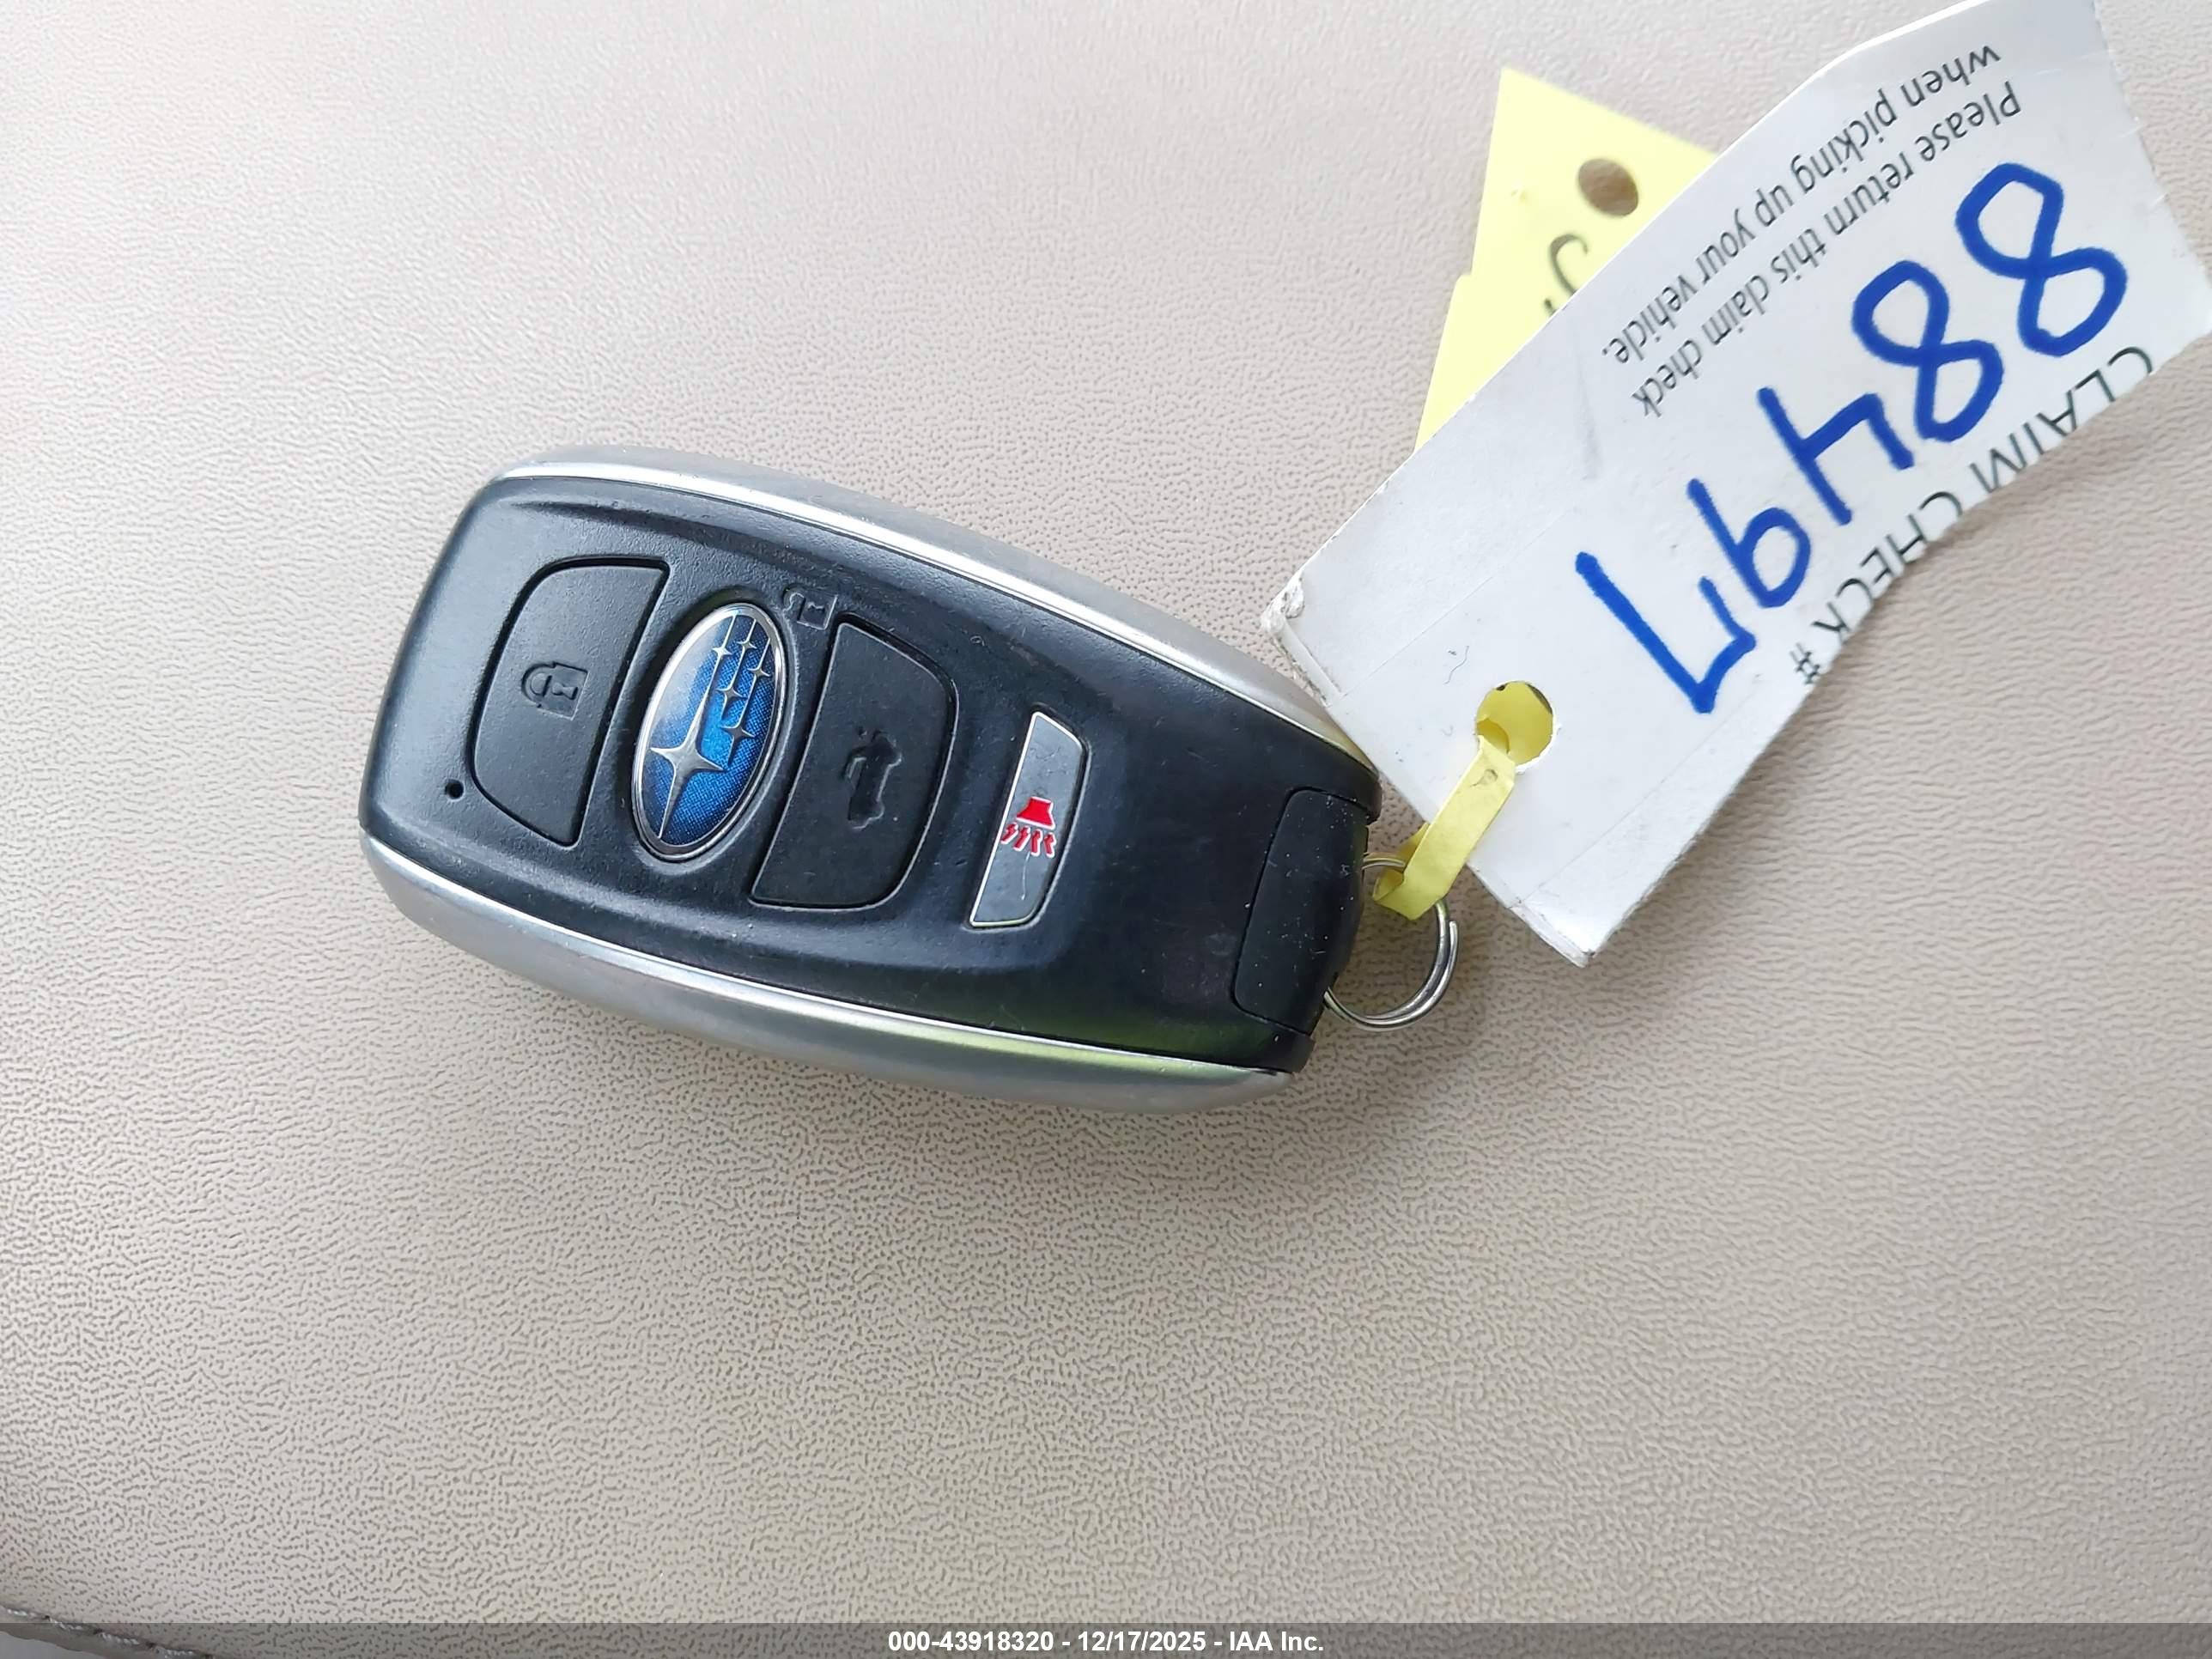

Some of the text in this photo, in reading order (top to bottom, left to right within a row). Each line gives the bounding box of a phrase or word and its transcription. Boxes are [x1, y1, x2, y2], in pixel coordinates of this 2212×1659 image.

[1601, 45, 2002, 364] when picking up your vehicle.
[1631, 81, 2021, 418] Please return this claim check
[1576, 163, 2127, 714] 88497
[1969, 346, 2154, 493] CLAIM
[1790, 642, 1821, 684] #
